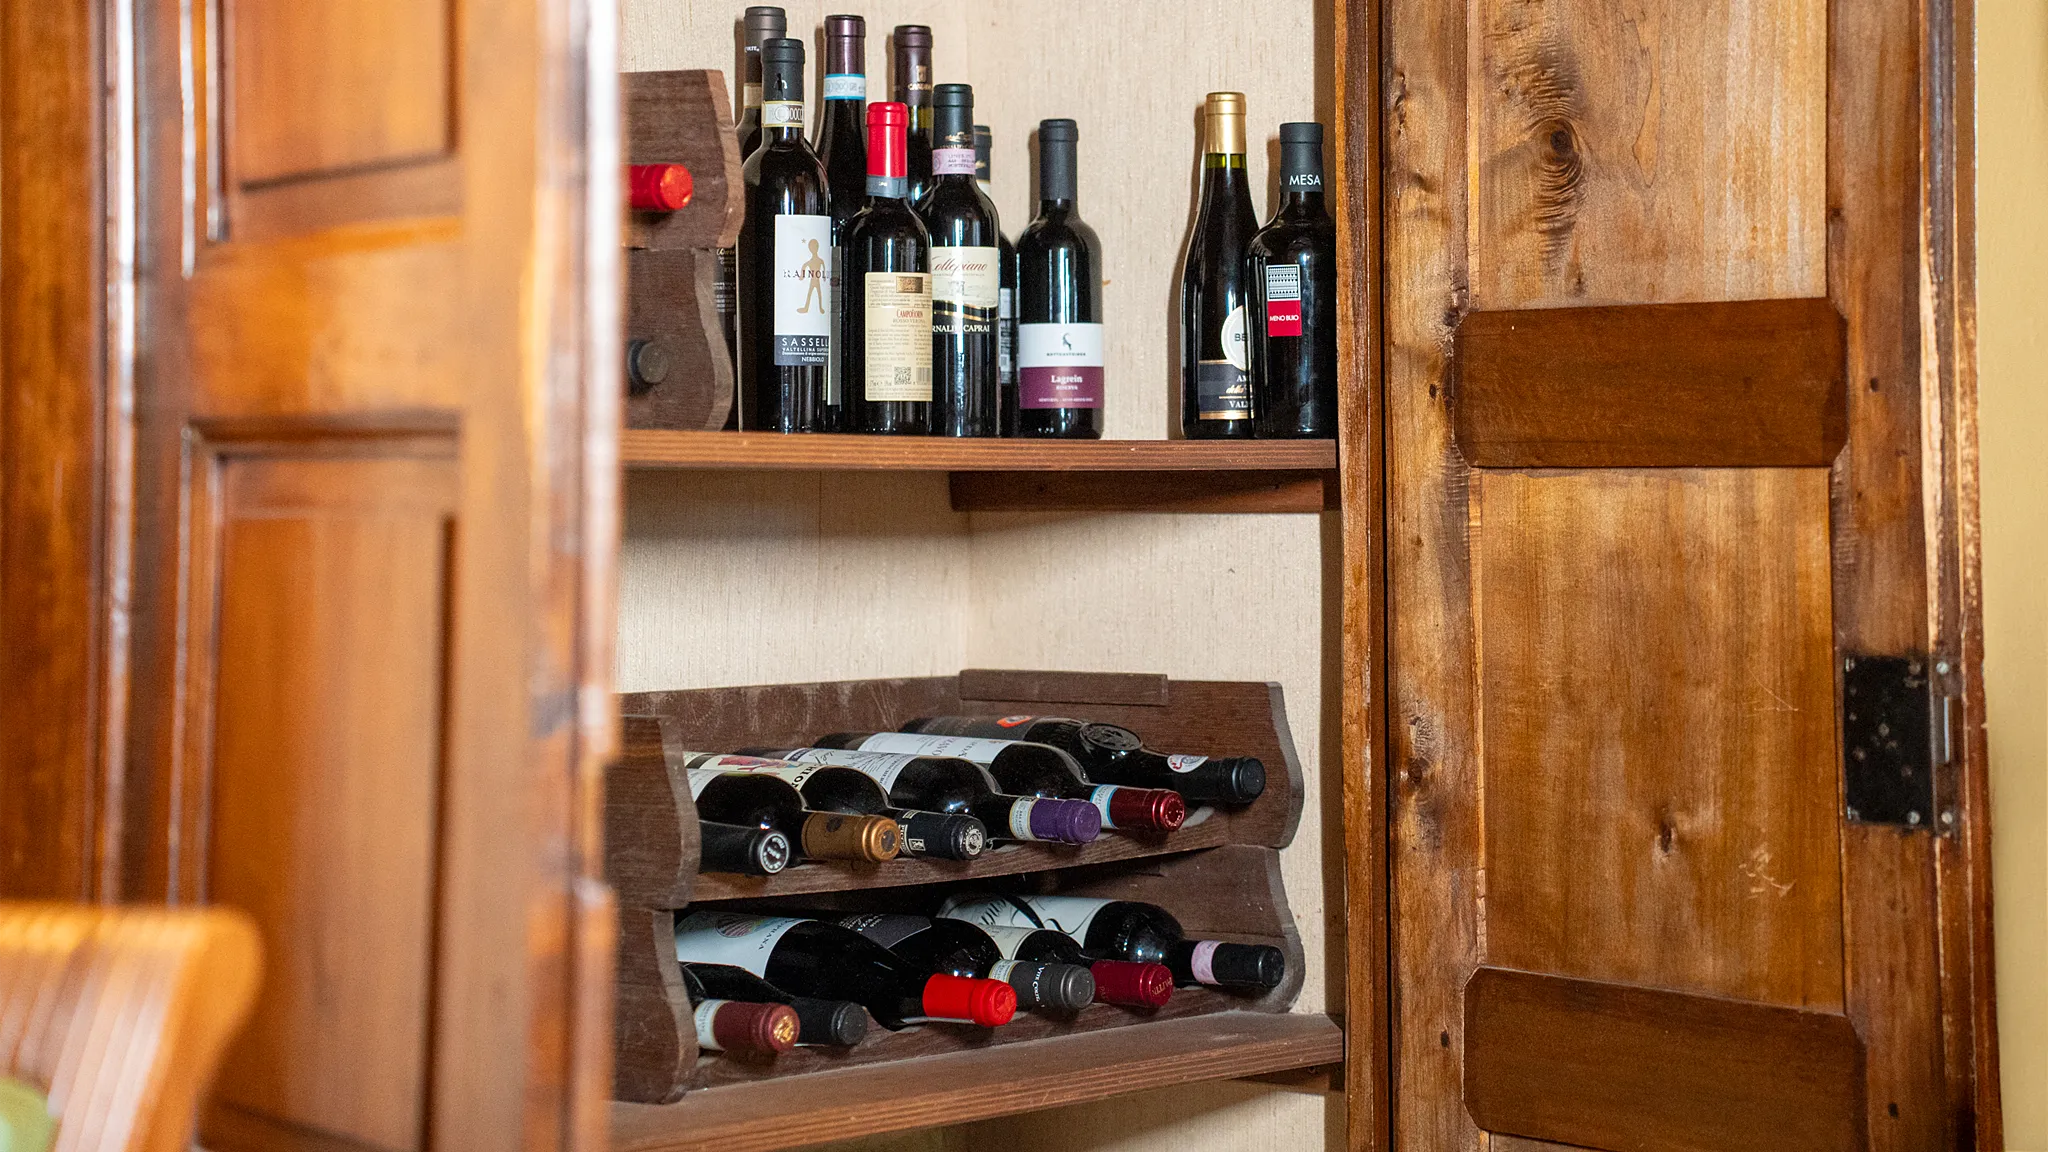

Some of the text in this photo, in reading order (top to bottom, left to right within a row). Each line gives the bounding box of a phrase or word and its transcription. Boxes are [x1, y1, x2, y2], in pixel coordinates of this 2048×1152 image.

[1289, 174, 1321, 186] MESA
[963, 324, 990, 333] CAPRAI
[1051, 374, 1083, 385] Lagrein
